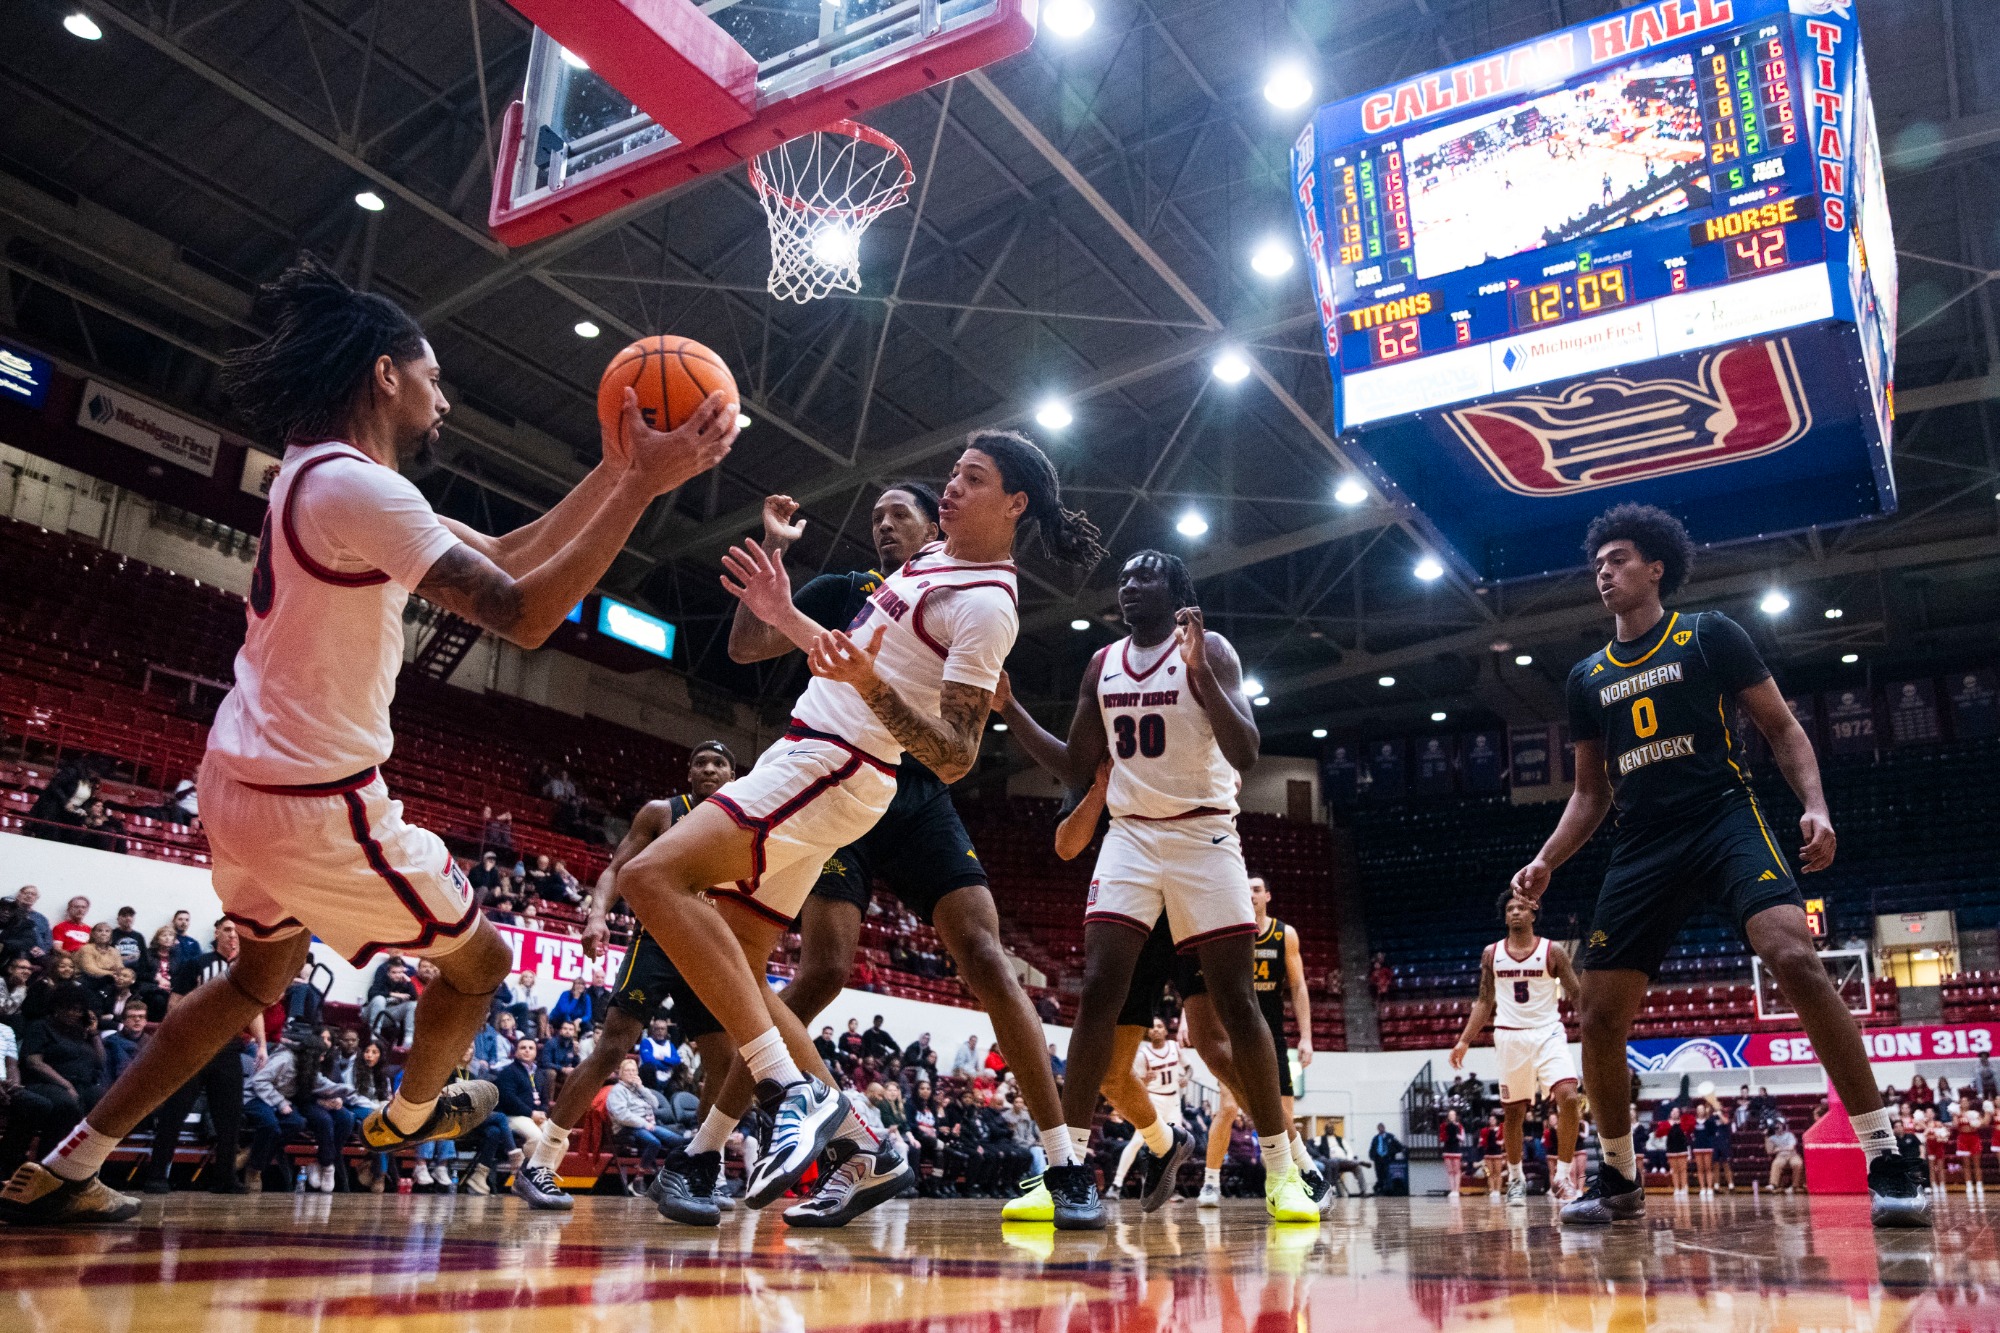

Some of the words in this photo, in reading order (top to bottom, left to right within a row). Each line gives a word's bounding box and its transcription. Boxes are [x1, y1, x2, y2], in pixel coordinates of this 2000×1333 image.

[1759, 25, 1779, 39] PTS
[1361, 33, 1574, 134] CALIHAN
[1588, 0, 1733, 64] HALL
[1712, 54, 1726, 76] 0
[1739, 48, 1747, 67] 1
[1768, 38, 1783, 58] 6
[1715, 76, 1730, 96] 5
[1736, 69, 1750, 90] 2
[1765, 59, 1786, 81] 10
[1718, 96, 1733, 118] 8
[1740, 91, 1754, 112] 3
[1768, 81, 1790, 103] 15
[1715, 118, 1736, 140] 11
[1743, 112, 1756, 133] 2
[1779, 102, 1793, 123] 6
[1806, 19, 1846, 232] TITANS
[1712, 139, 1740, 165] 24
[1746, 133, 1760, 154] 2
[1782, 124, 1795, 145] 2
[1343, 165, 1355, 185] 2
[1360, 161, 1372, 179] 2
[1388, 152, 1401, 171] 0
[1728, 168, 1743, 189] 5
[1345, 186, 1357, 205] 5
[1362, 181, 1375, 199] 3
[1386, 172, 1403, 191] 15
[1729, 189, 1766, 207] BONUS
[1341, 205, 1359, 224] 11
[1369, 200, 1376, 217] 1
[1388, 192, 1405, 211] 13
[1706, 198, 1798, 241] NORSE
[1344, 224, 1361, 243] 13
[1372, 219, 1379, 236] 1
[1395, 211, 1407, 229] 0
[1340, 243, 1363, 265] 30
[1368, 239, 1381, 257] 3
[1398, 231, 1410, 250] 3
[1578, 252, 1590, 273] 2
[1664, 256, 1688, 269] TOL
[1737, 228, 1785, 269] 42
[1400, 257, 1413, 274] 7
[1542, 260, 1577, 277] PERIOD
[1672, 269, 1685, 290] 2
[1349, 292, 1432, 331] TITANS
[1530, 268, 1625, 323] 12:09
[1451, 310, 1472, 321] TOL
[1457, 322, 1469, 341] 3
[1378, 320, 1419, 360] 62
[1530, 331, 1603, 358] Michigan
[1606, 320, 1642, 341] First
[115, 408, 180, 442] Michigan
[1103, 692, 1140, 709] DETROIT
[1142, 690, 1179, 707] MERCY
[1600, 661, 1684, 709] NORTHERN
[1631, 697, 1658, 739] 0
[1113, 713, 1166, 759] 30
[1617, 733, 1696, 777] KENTUCKY
[1252, 949, 1277, 959] THERN
[1252, 981, 1277, 992] TUCKY
[1513, 981, 1530, 1004] 5
[1768, 1032, 1922, 1063] SEION
[1933, 1027, 1993, 1055] 313
[1161, 1070, 1173, 1086] 11
